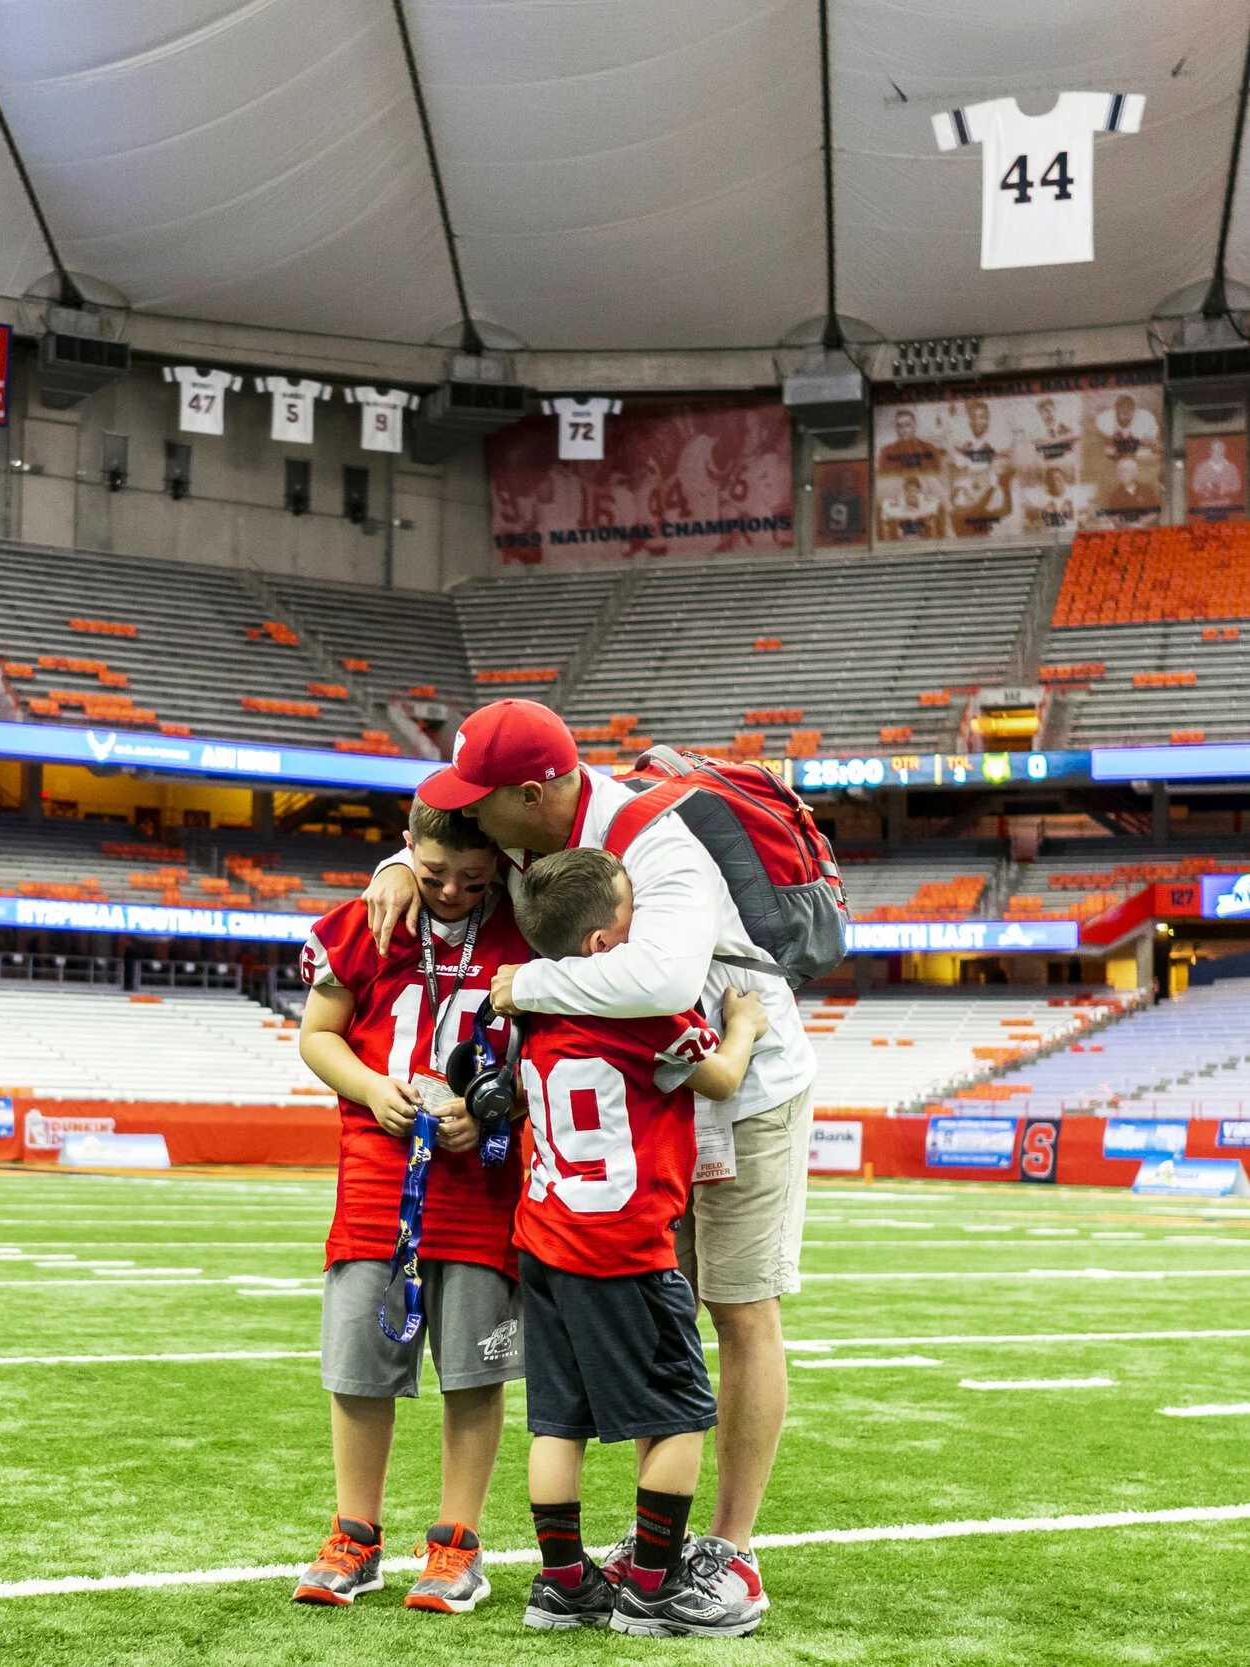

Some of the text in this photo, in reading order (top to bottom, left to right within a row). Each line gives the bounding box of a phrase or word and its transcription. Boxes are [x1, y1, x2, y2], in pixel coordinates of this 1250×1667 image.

[1001, 152, 1074, 204] 44
[188, 393, 216, 415] 47
[285, 404, 299, 424] 5
[567, 422, 595, 442] 72
[829, 503, 849, 530] 9
[549, 526, 652, 546] NATIONAL
[660, 514, 792, 538] CHAMPIONS
[802, 756, 884, 788] 25:00
[891, 755, 920, 771] QTR
[1028, 754, 1047, 780] 0
[1171, 889, 1194, 906] 127
[127, 906, 226, 934] FOOTBALL
[855, 924, 987, 949] NORTH EAST
[458, 943, 474, 979] NYSPHSAA
[1021, 1122, 1057, 1179] S
[695, 1168, 731, 1179] SPOTTER
[700, 1161, 725, 1171] FIELD
